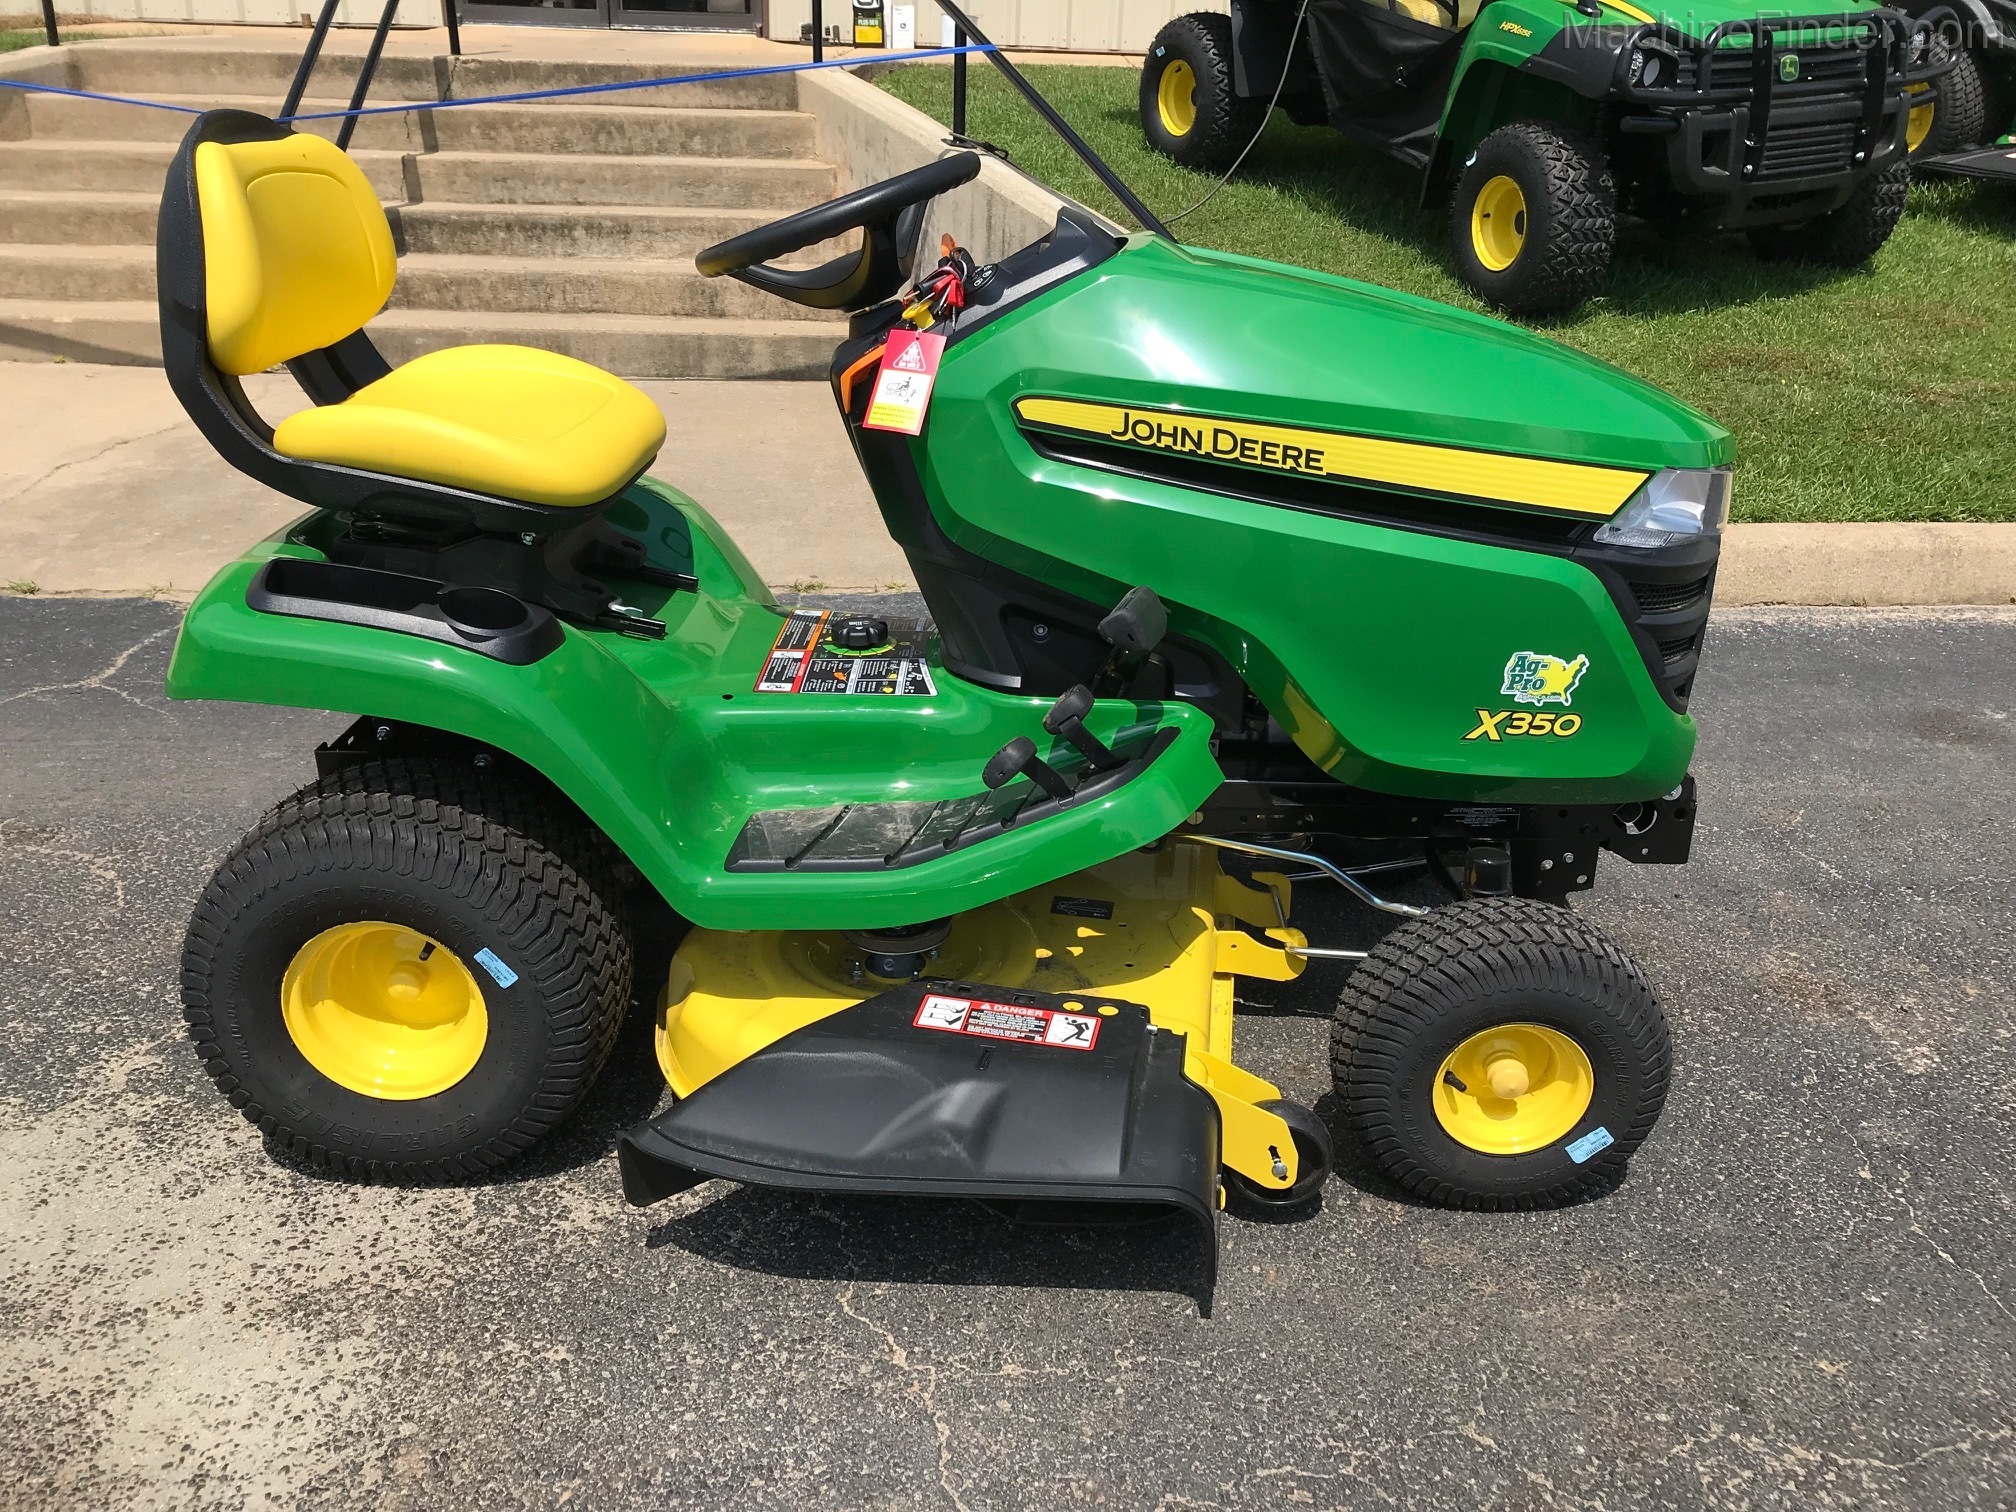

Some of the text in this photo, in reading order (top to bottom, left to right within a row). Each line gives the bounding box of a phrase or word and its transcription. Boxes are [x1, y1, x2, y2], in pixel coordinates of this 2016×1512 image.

[1111, 411, 1326, 473] JOHN DEERE
[1505, 673, 1546, 692] Pro
[1460, 708, 1582, 742] X350
[358, 884, 439, 917] TRAC
[994, 1004, 1043, 1017] DANGER
[281, 1100, 480, 1153] CARLISLE
